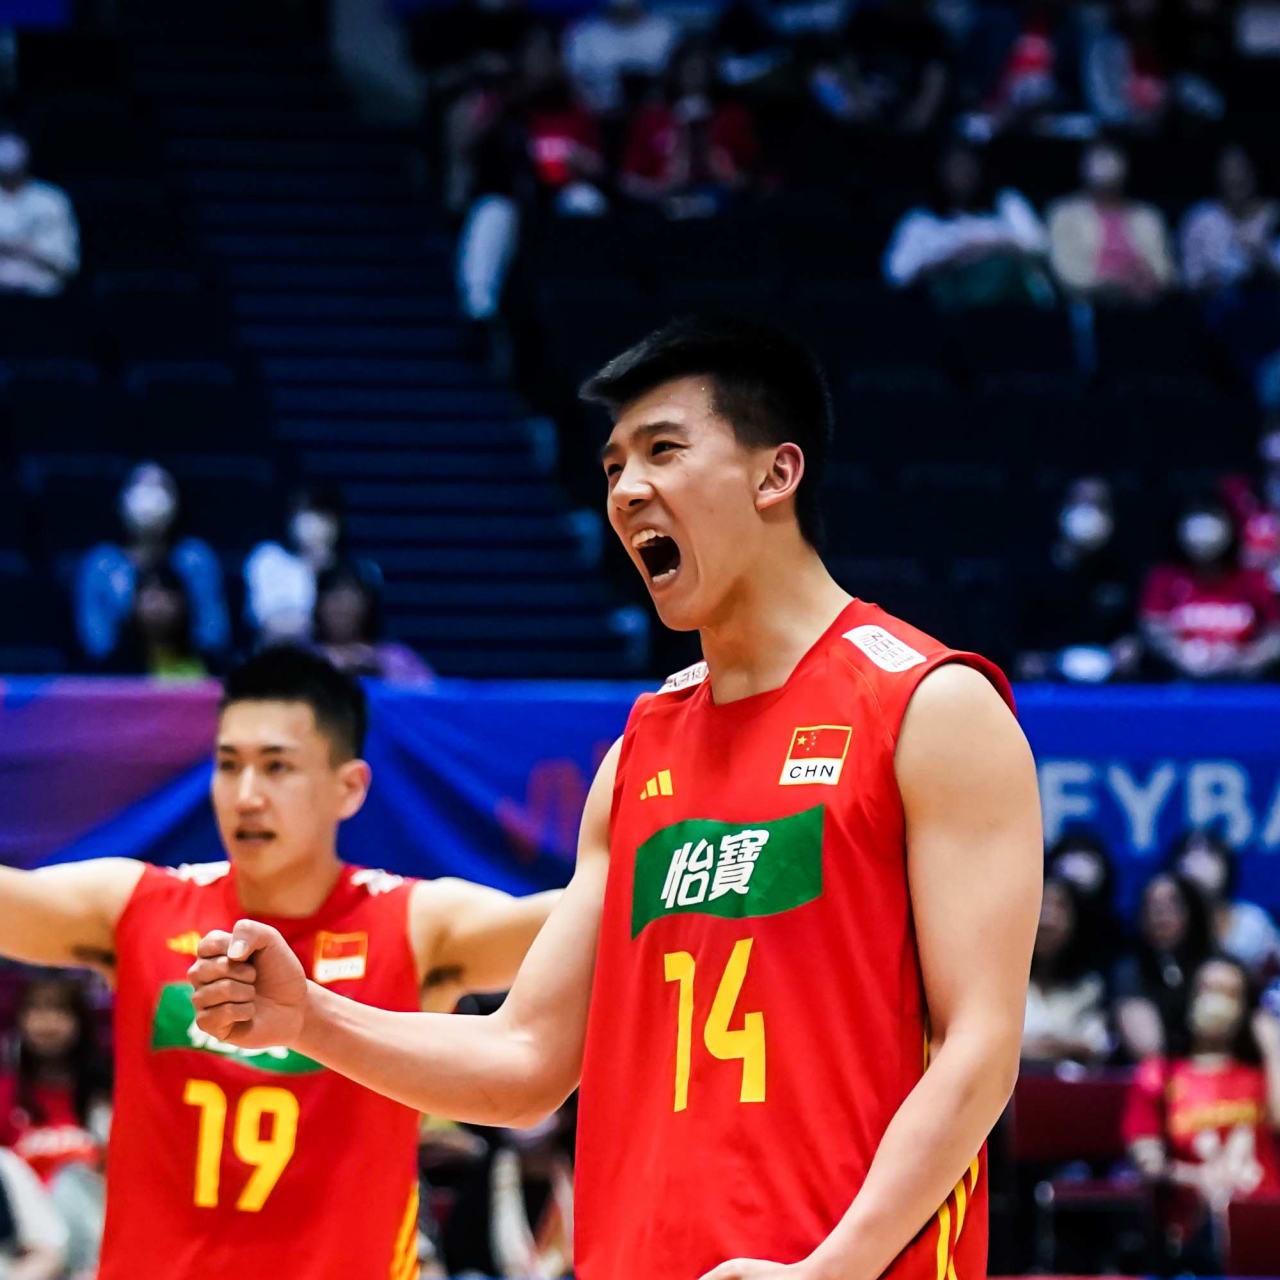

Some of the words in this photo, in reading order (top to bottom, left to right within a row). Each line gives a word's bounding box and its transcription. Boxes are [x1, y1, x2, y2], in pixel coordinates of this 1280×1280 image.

[789, 764, 835, 779] CHN
[660, 829, 770, 909] 怡寶
[664, 938, 767, 1112] 14
[183, 1080, 299, 1212] 19
